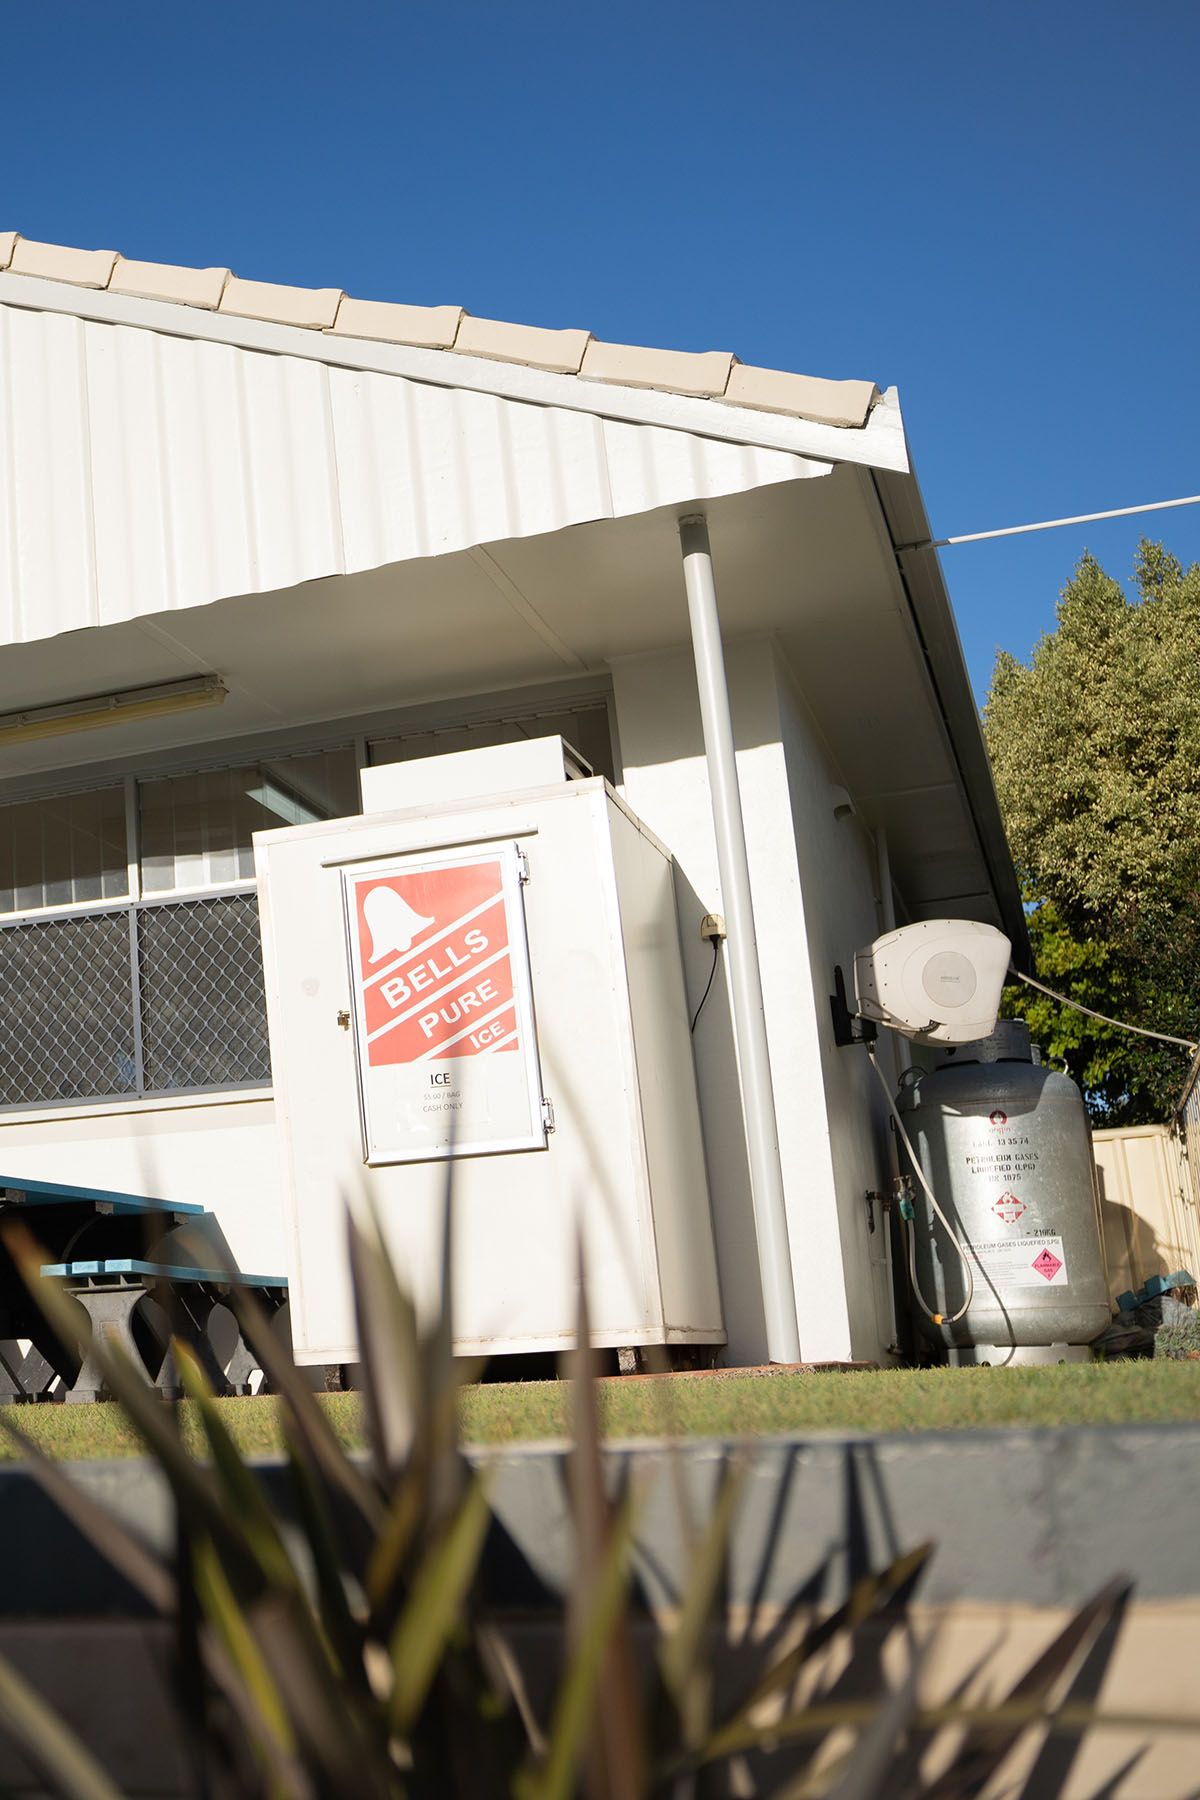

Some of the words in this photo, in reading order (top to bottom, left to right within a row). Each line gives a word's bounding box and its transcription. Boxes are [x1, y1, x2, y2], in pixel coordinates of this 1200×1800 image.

[379, 929, 489, 1009] BELLS
[417, 979, 499, 1039] PURE
[469, 1021, 505, 1050] ICE
[430, 1072, 451, 1085] ICE
[447, 1090, 461, 1099] BAG
[423, 1104, 442, 1113] CASH
[443, 1102, 464, 1111] ONLY
[1019, 1137, 1029, 1145] 74
